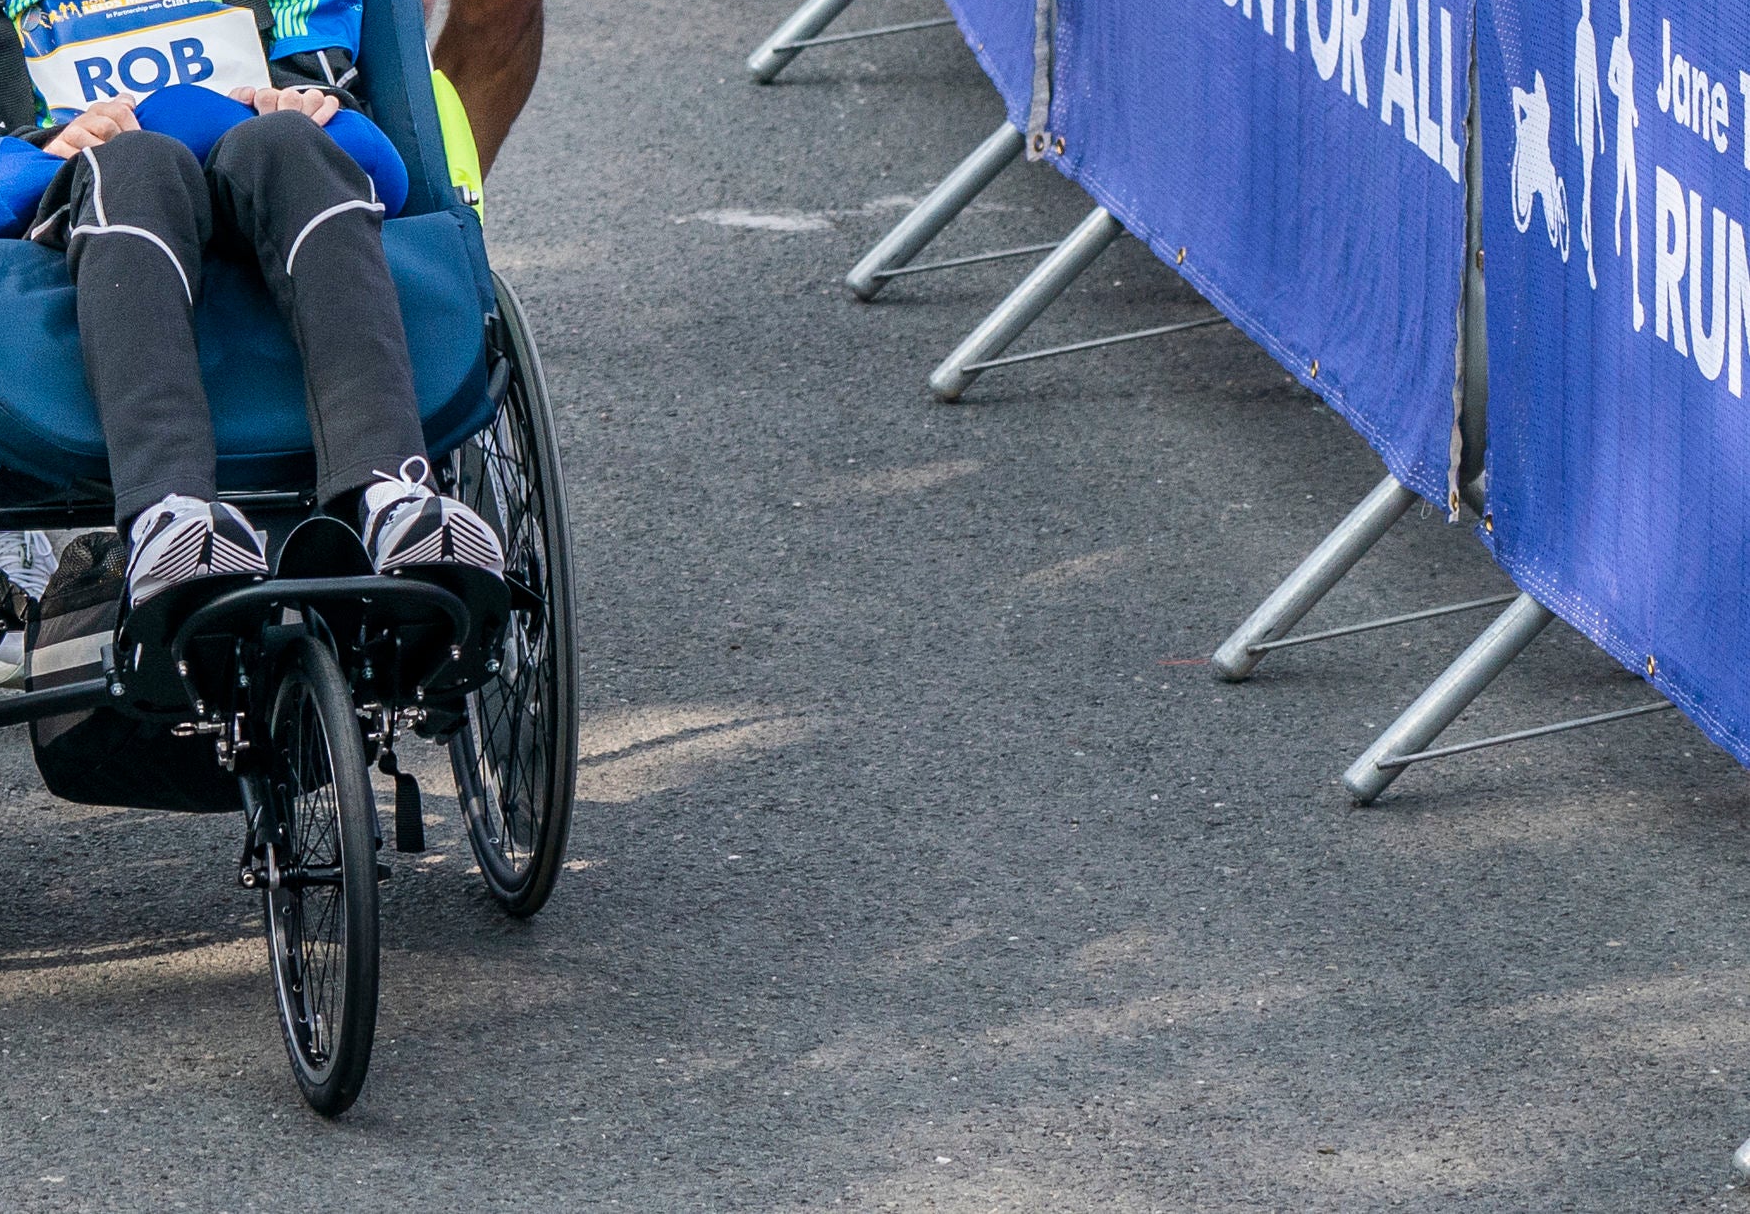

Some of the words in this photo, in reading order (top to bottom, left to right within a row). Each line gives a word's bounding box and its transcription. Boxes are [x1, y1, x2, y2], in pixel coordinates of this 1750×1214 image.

[113, 6, 149, 18] Partnership
[148, 2, 162, 11] with
[74, 37, 215, 103] ROB
[1655, 17, 1730, 154] Jane
